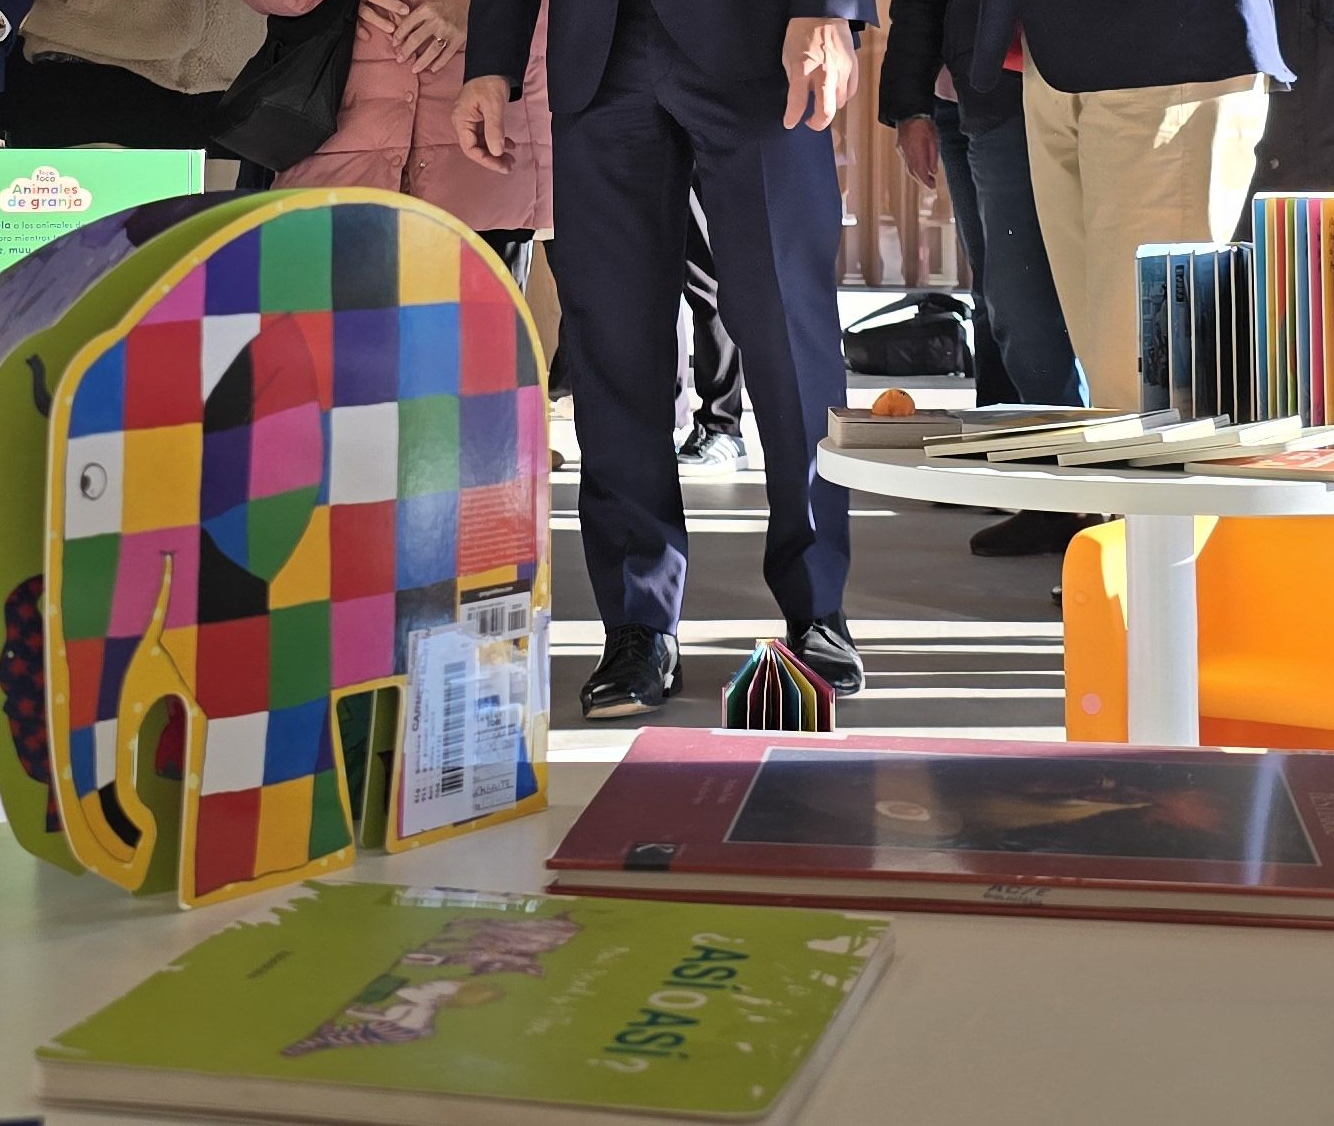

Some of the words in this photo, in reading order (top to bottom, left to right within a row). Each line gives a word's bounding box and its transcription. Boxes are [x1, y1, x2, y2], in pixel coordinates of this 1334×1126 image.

[11, 183, 78, 195] Animales
[7, 195, 27, 207] de
[30, 195, 83, 210] granja
[21, 221, 34, 230] los
[36, 221, 73, 230] animales
